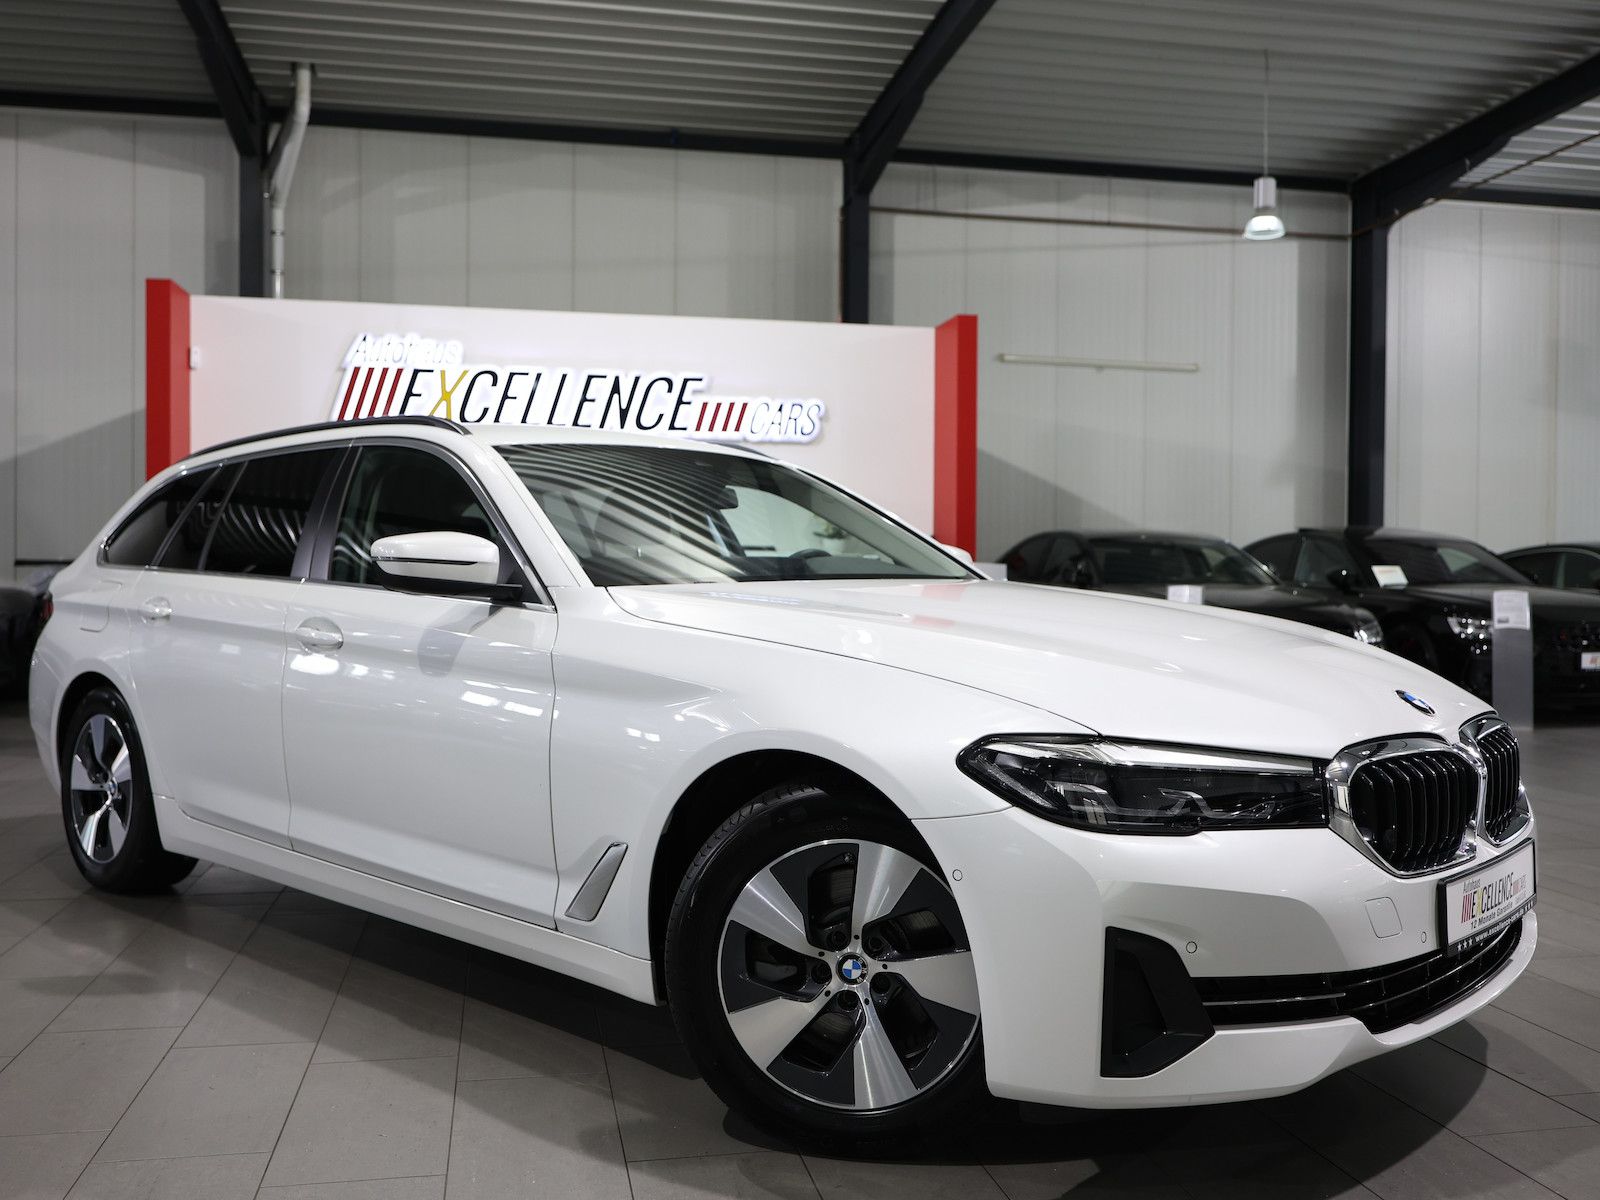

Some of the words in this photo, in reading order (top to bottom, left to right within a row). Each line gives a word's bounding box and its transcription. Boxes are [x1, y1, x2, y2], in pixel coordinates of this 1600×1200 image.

[398, 369, 704, 432] EXCELLENCE
[750, 401, 821, 437] CARS
[1471, 872, 1514, 918] EXCELLENCE
[1471, 920, 1477, 929] 12
[1478, 912, 1496, 926] Monate
